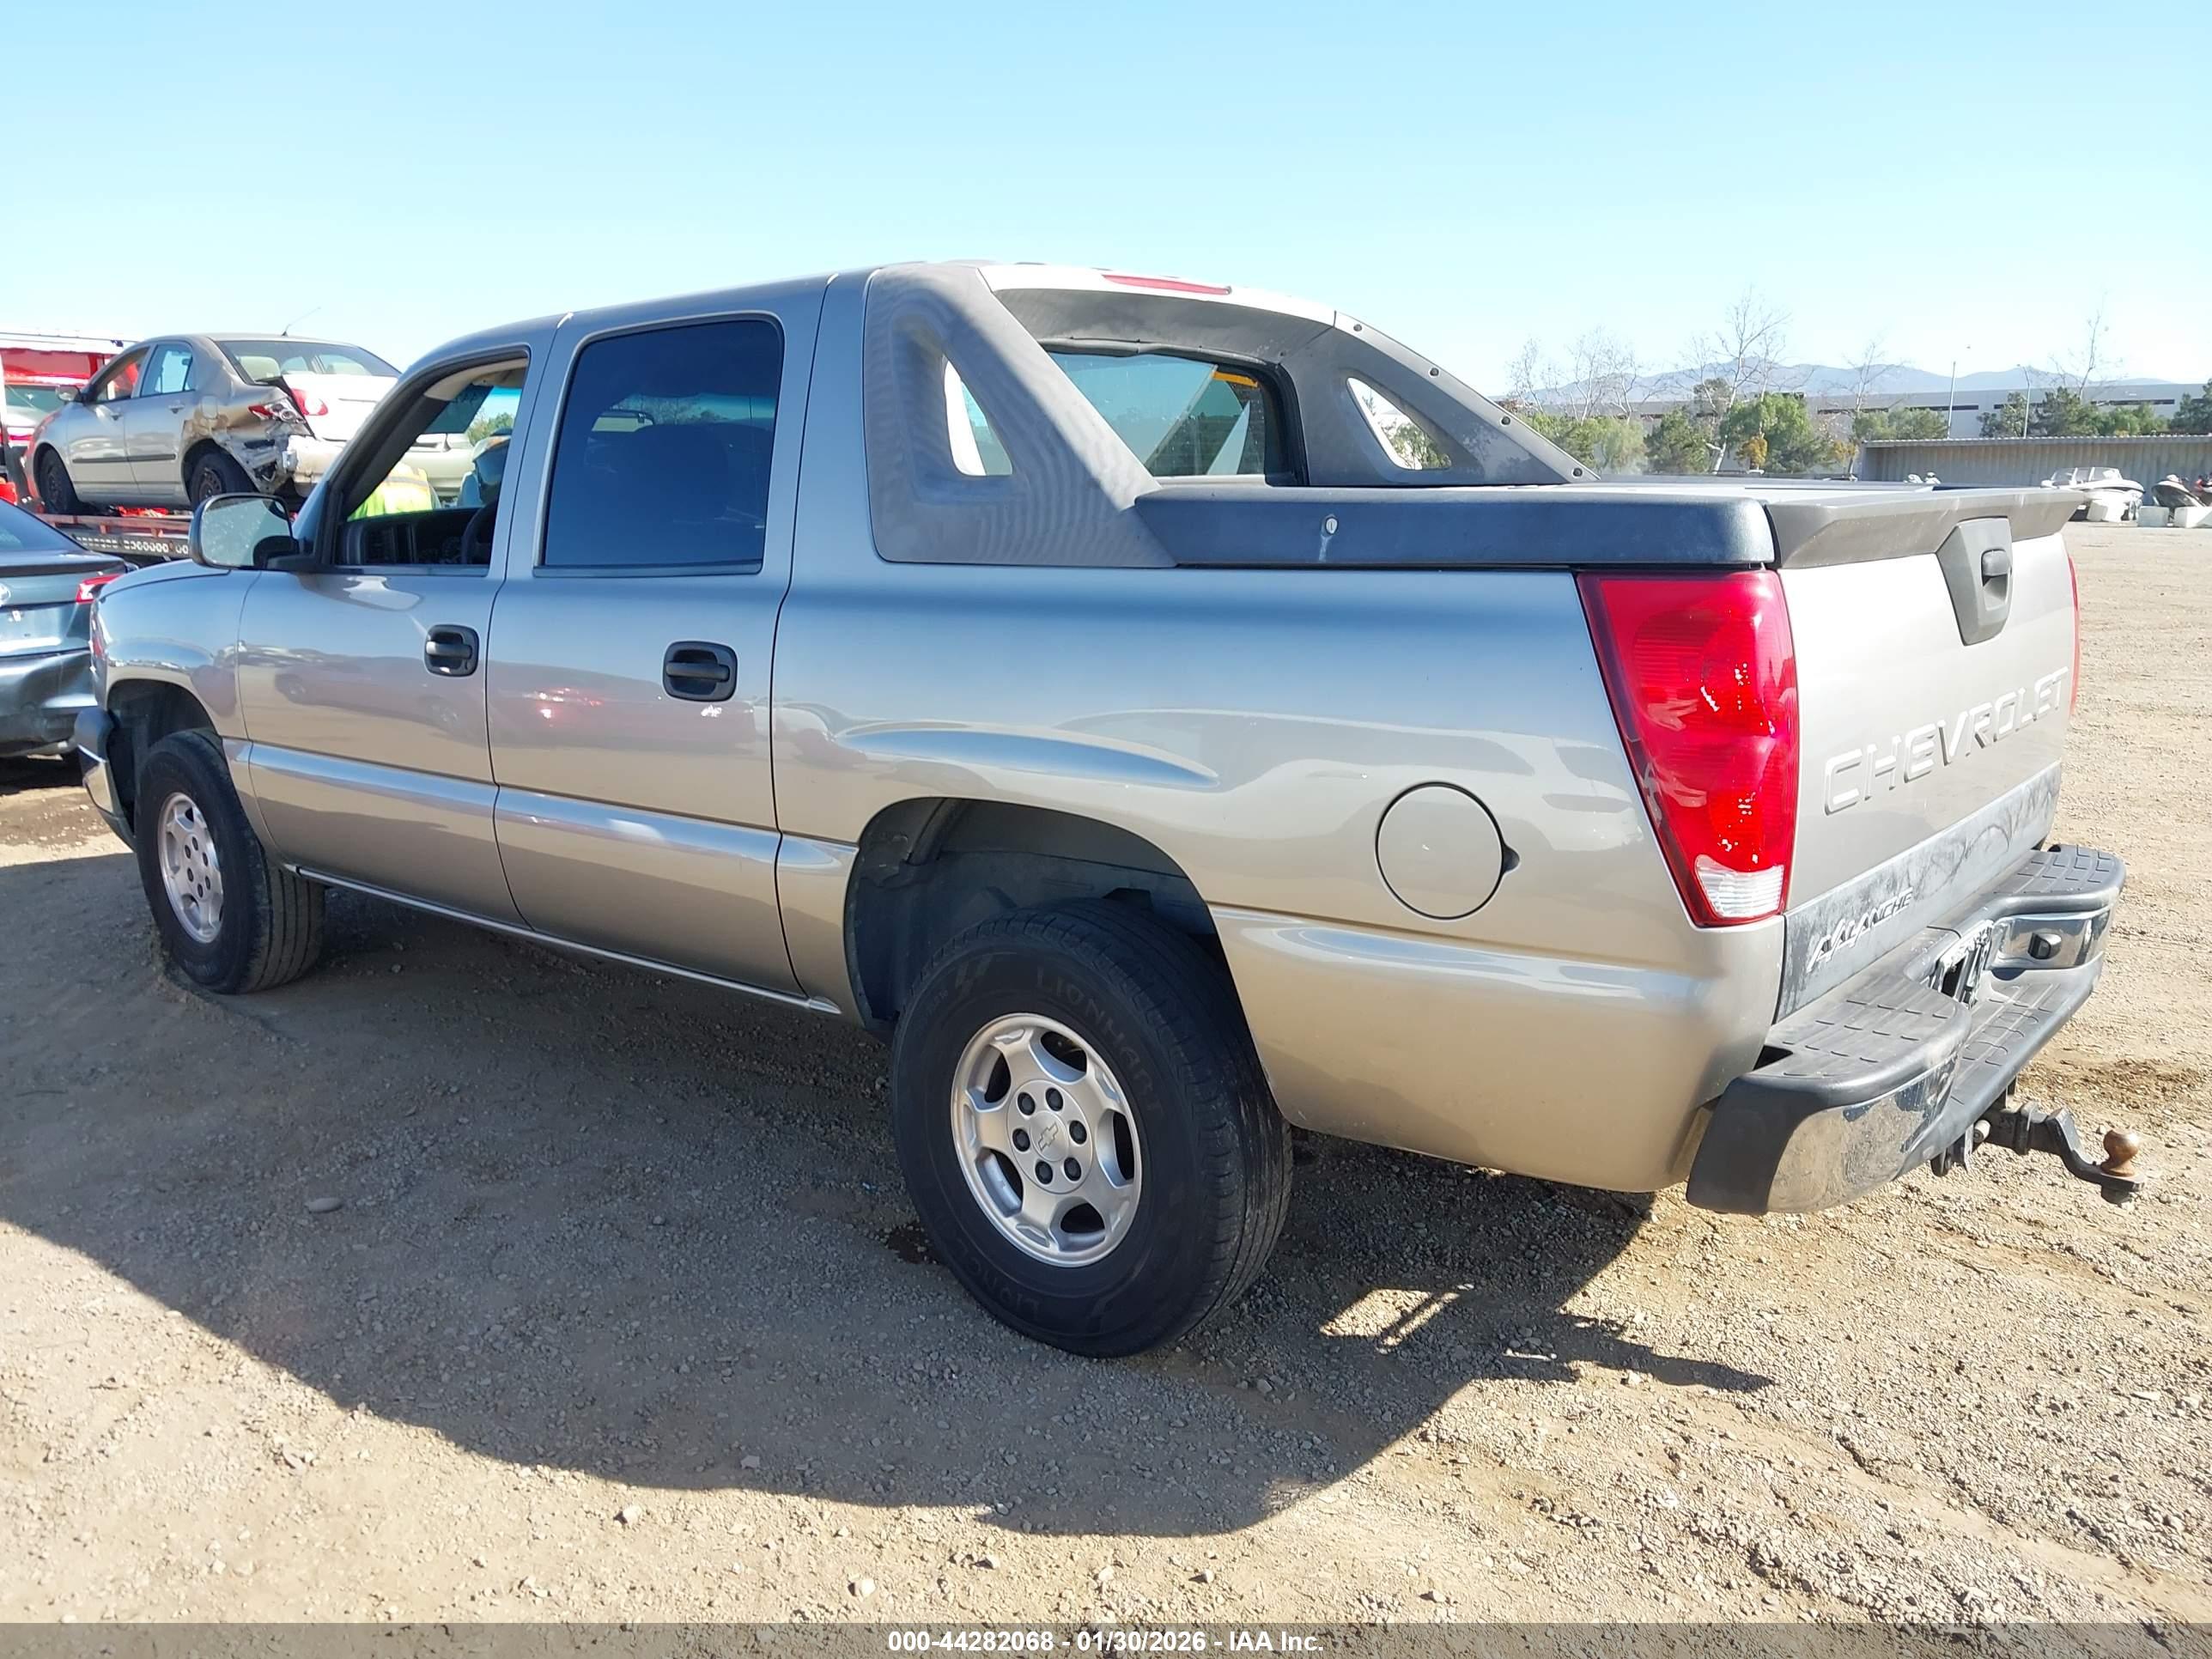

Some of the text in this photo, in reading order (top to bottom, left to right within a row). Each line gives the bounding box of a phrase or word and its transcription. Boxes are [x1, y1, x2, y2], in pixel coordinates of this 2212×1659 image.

[1823, 666, 2069, 817] CHEVROLET
[1806, 887, 1913, 973] AVALANCHE
[1036, 965, 1164, 1114] LIONHART
